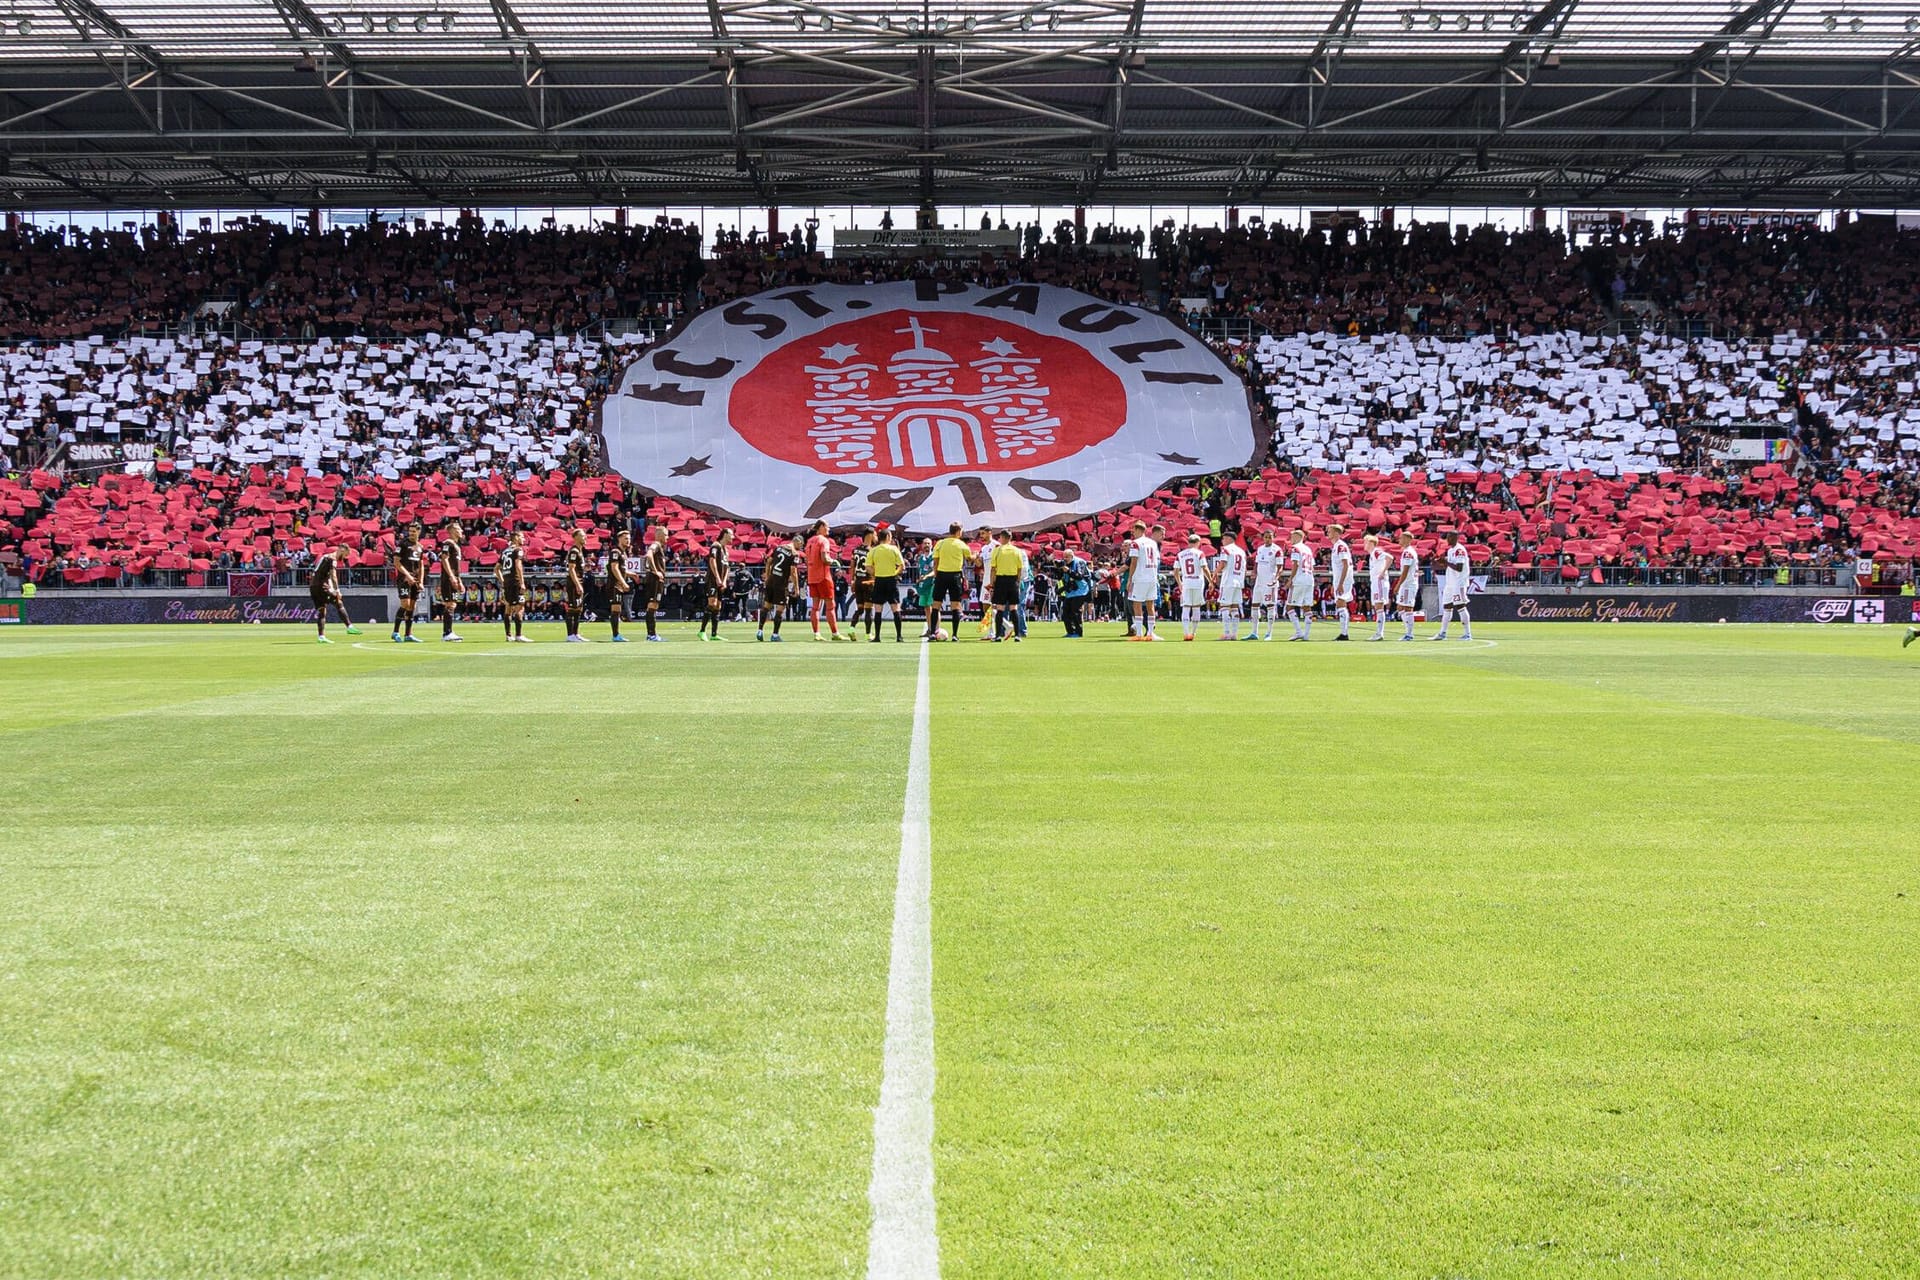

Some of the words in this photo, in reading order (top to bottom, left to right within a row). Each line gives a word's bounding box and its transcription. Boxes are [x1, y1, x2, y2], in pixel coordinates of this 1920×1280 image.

[624, 349, 736, 406] FC
[914, 279, 1223, 385] PAULI
[70, 444, 114, 460] SANKT
[1708, 435, 1732, 451] 1910
[803, 476, 1082, 526] 1910
[502, 553, 513, 570] 25
[628, 561, 639, 570] D2
[774, 553, 785, 571] 2
[855, 554, 867, 573] 23
[1185, 558, 1195, 575] 6
[1235, 552, 1242, 571] 8
[1859, 562, 1871, 571] C2
[165, 600, 239, 620] Ehrenwerte
[1517, 598, 1592, 618] Ehrenwerte
[1593, 598, 1677, 622] Gesellschaft
